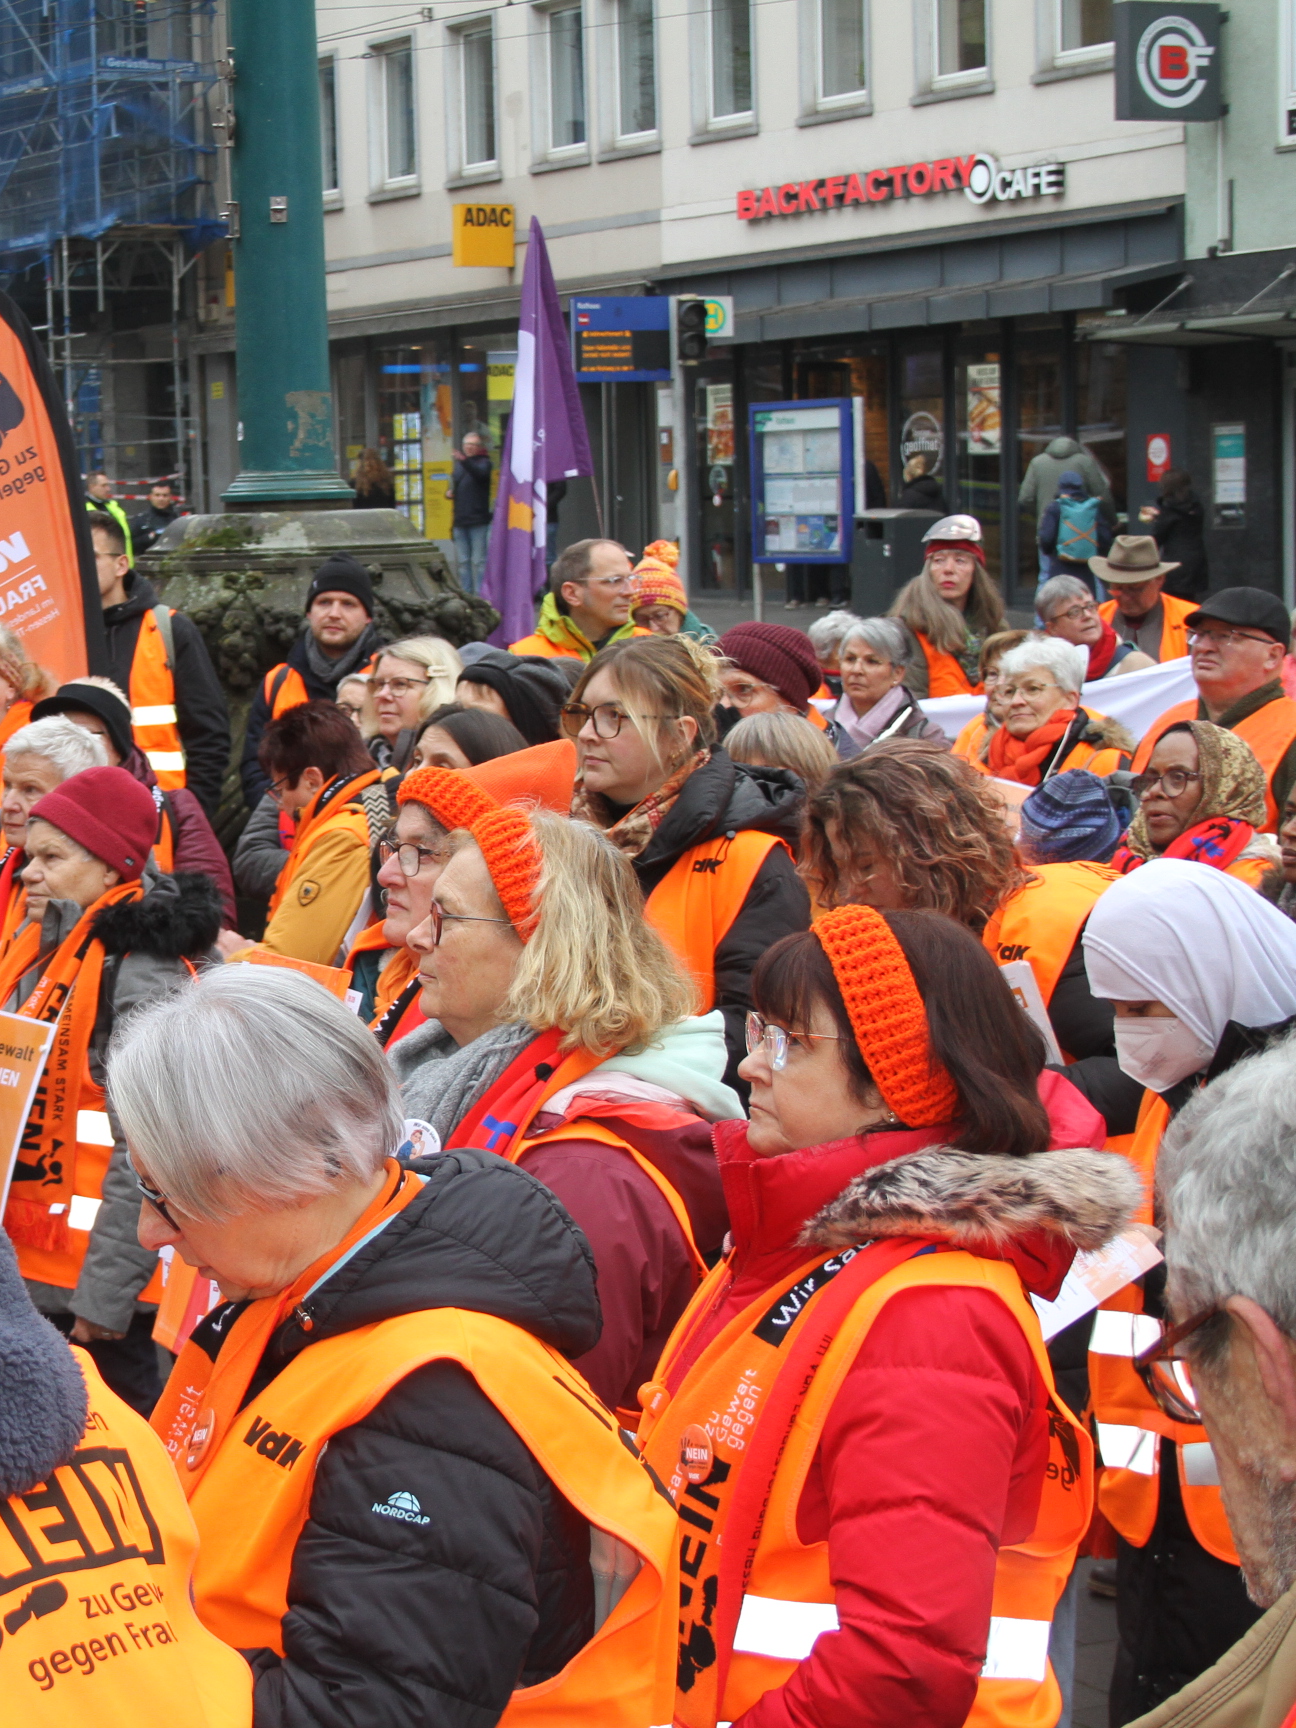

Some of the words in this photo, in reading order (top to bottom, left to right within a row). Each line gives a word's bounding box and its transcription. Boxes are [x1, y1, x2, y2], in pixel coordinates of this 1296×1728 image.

[463, 207, 512, 227] ADAC
[487, 365, 515, 378] ADAC
[692, 857, 725, 875] dK
[51, 1076, 67, 1122] STARK
[771, 1277, 815, 1325] Wir
[163, 1385, 205, 1455] ewalt
[704, 1409, 719, 1437] zu
[715, 1368, 757, 1443] Gewalt
[727, 1385, 763, 1452] gegen
[243, 1414, 307, 1472] VdK
[685, 1446, 708, 1460] NEIN
[371, 1502, 431, 1525] NORDCAP
[78, 1590, 114, 1619] zu
[28, 1630, 129, 1691] gegen
